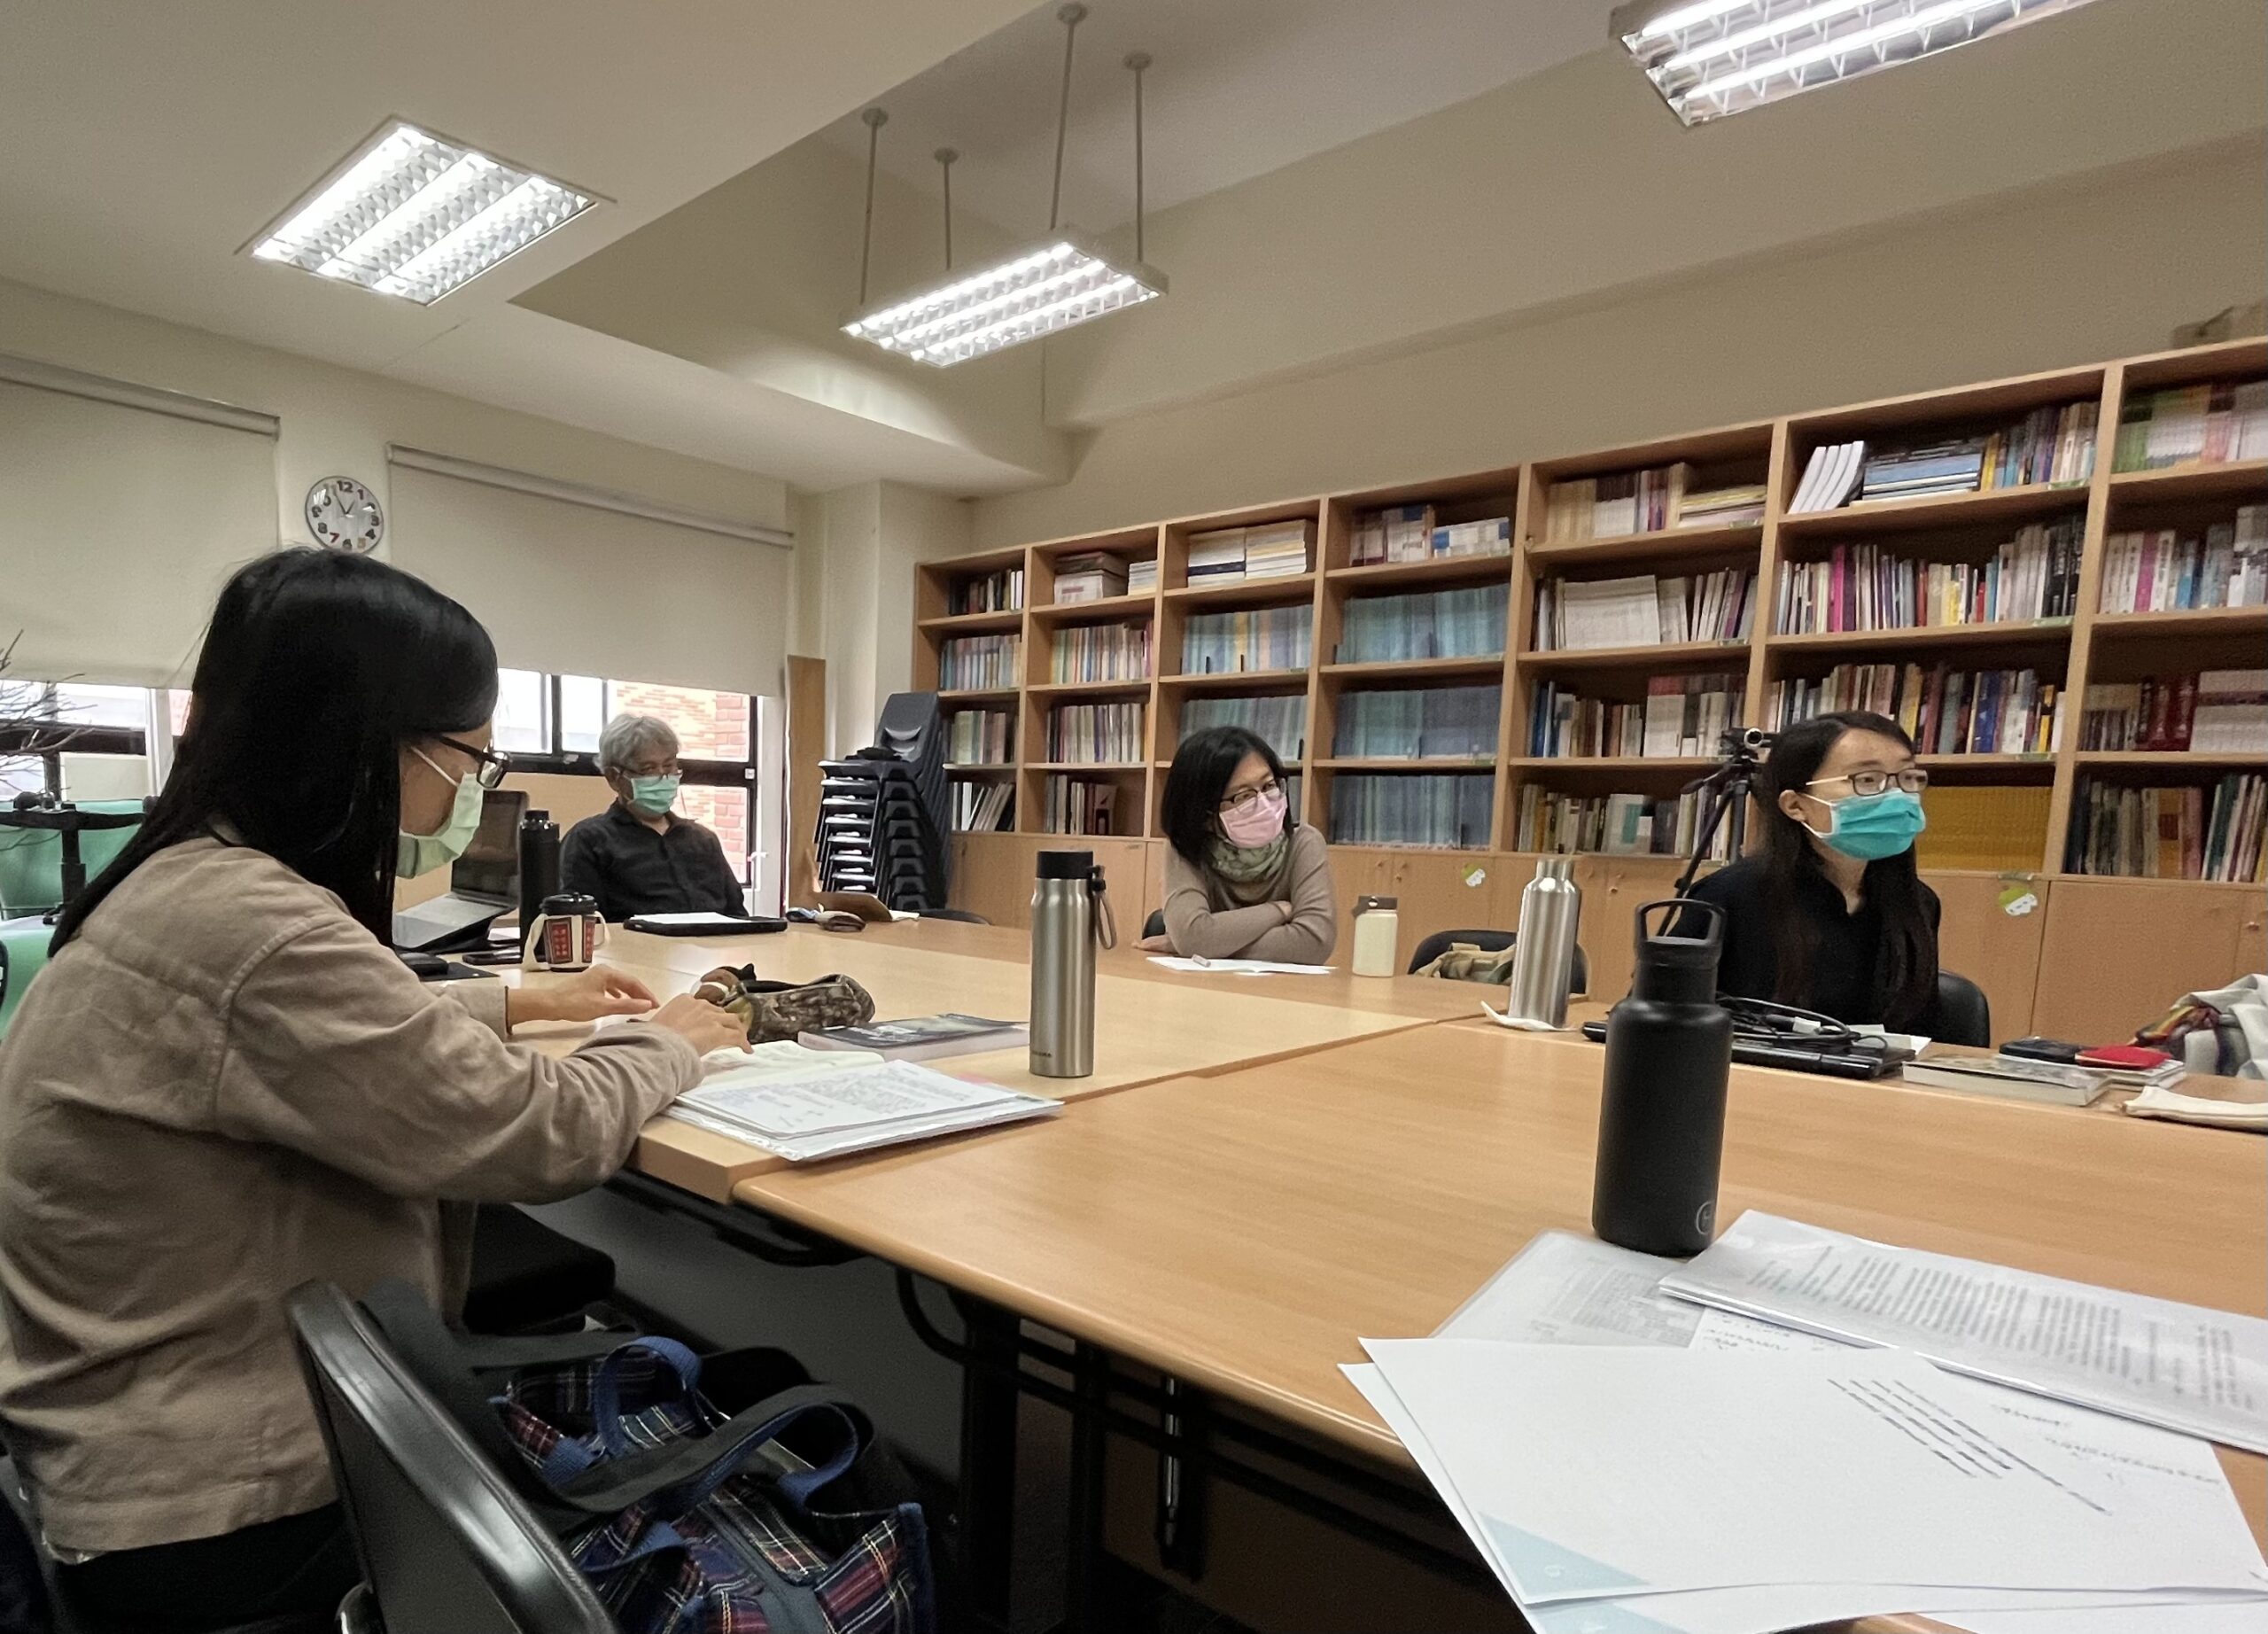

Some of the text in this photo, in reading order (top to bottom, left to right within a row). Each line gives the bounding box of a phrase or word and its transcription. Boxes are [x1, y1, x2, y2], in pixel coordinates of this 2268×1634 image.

[337, 480, 353, 493] 12
[357, 489, 364, 501] 1
[330, 532, 340, 543] 7
